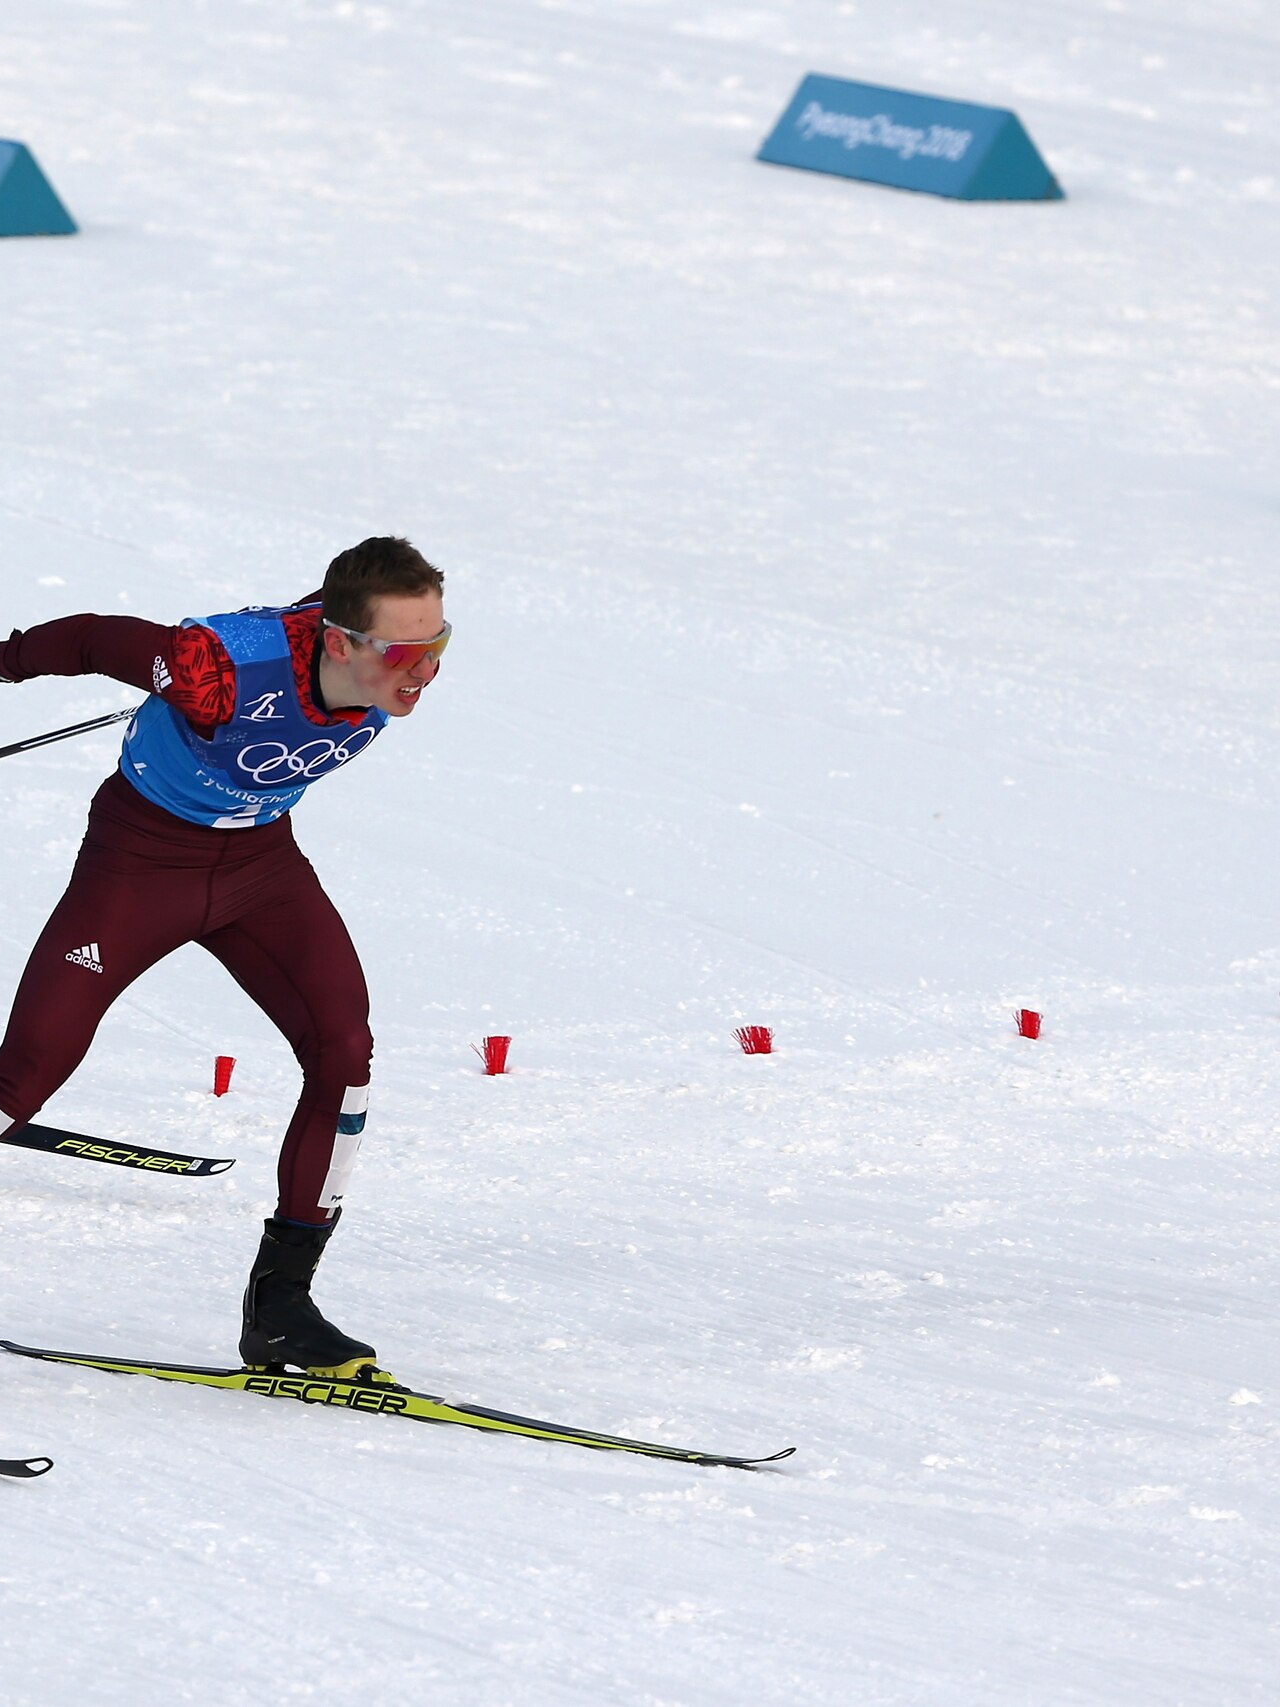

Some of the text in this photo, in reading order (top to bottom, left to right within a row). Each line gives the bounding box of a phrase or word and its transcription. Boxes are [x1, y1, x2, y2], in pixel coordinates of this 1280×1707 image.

[65, 953, 104, 974] adidas
[55, 1139, 191, 1173] FISCHER
[244, 1377, 408, 1413] FISCHER
